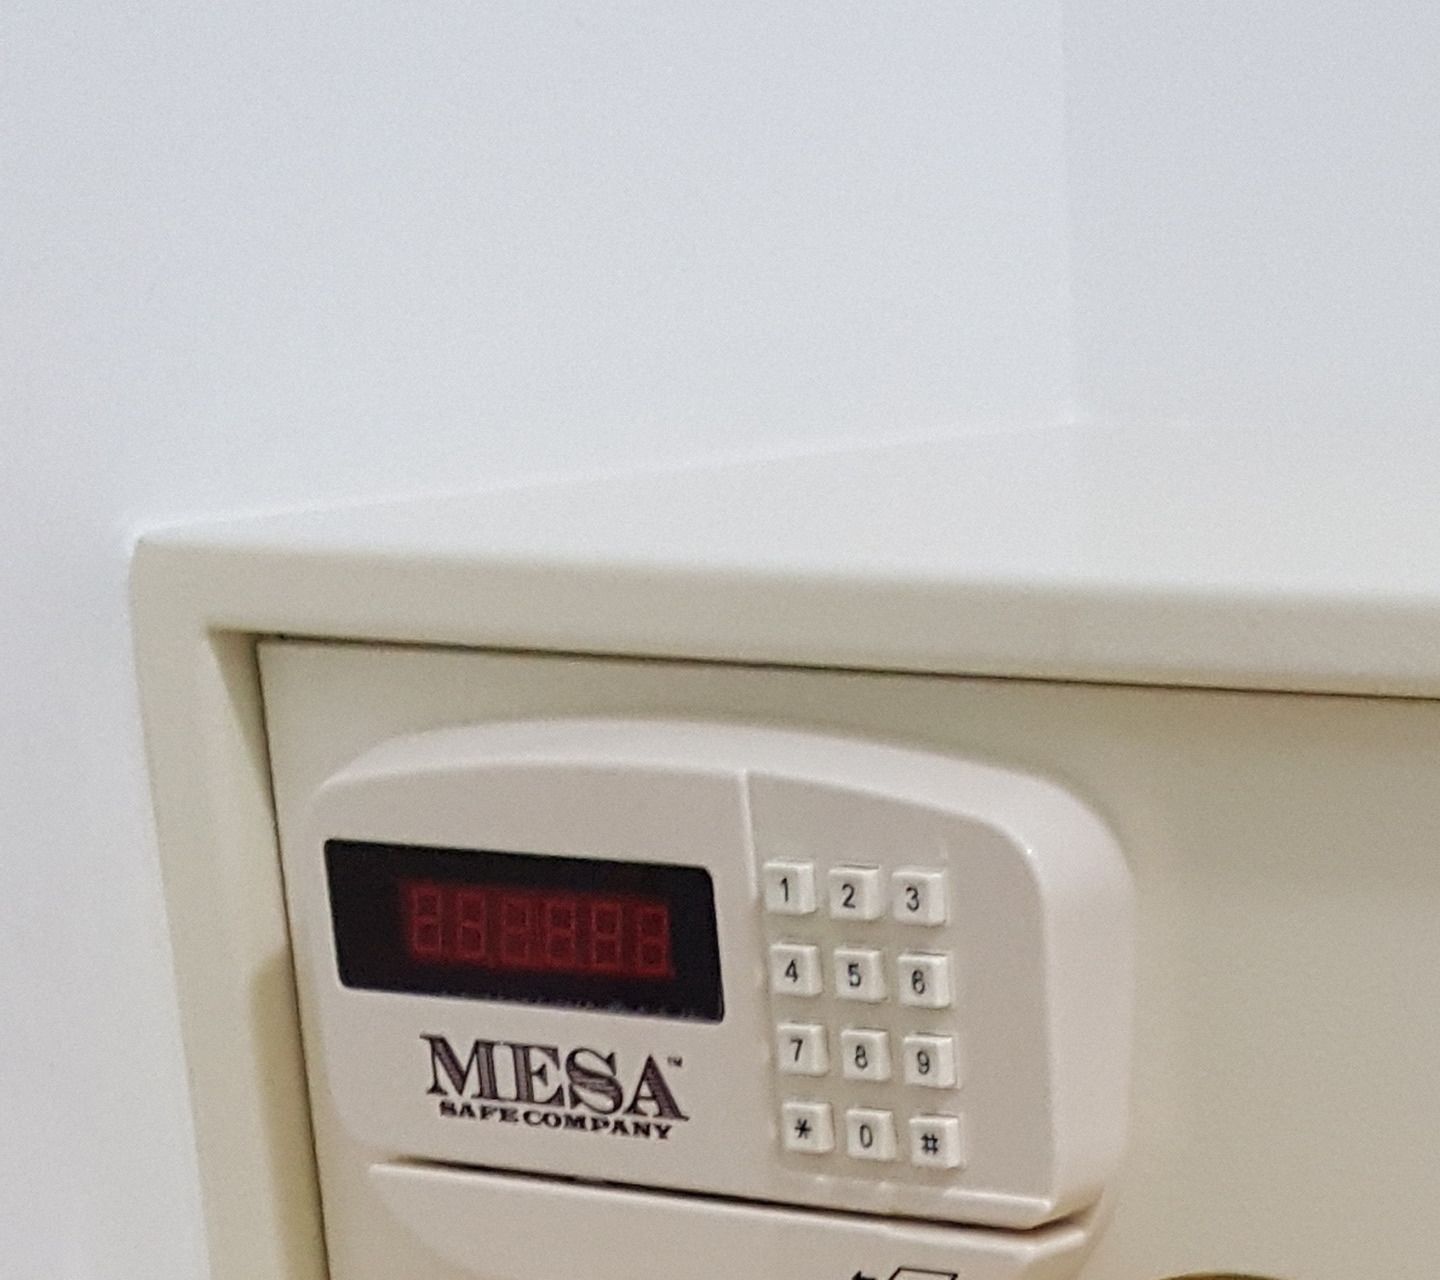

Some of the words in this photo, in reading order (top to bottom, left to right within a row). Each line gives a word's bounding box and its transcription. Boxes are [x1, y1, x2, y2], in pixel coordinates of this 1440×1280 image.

[780, 877, 790, 902] 1
[841, 883, 856, 908] 2
[905, 886, 920, 912] 3
[784, 959, 799, 983] 4
[847, 963, 861, 987] 5
[911, 969, 925, 995] 6
[790, 1038, 803, 1062] 7
[855, 1044, 868, 1069] 8
[916, 1050, 930, 1075] 9
[419, 1031, 690, 1122] MESA
[859, 1124, 873, 1148] 0
